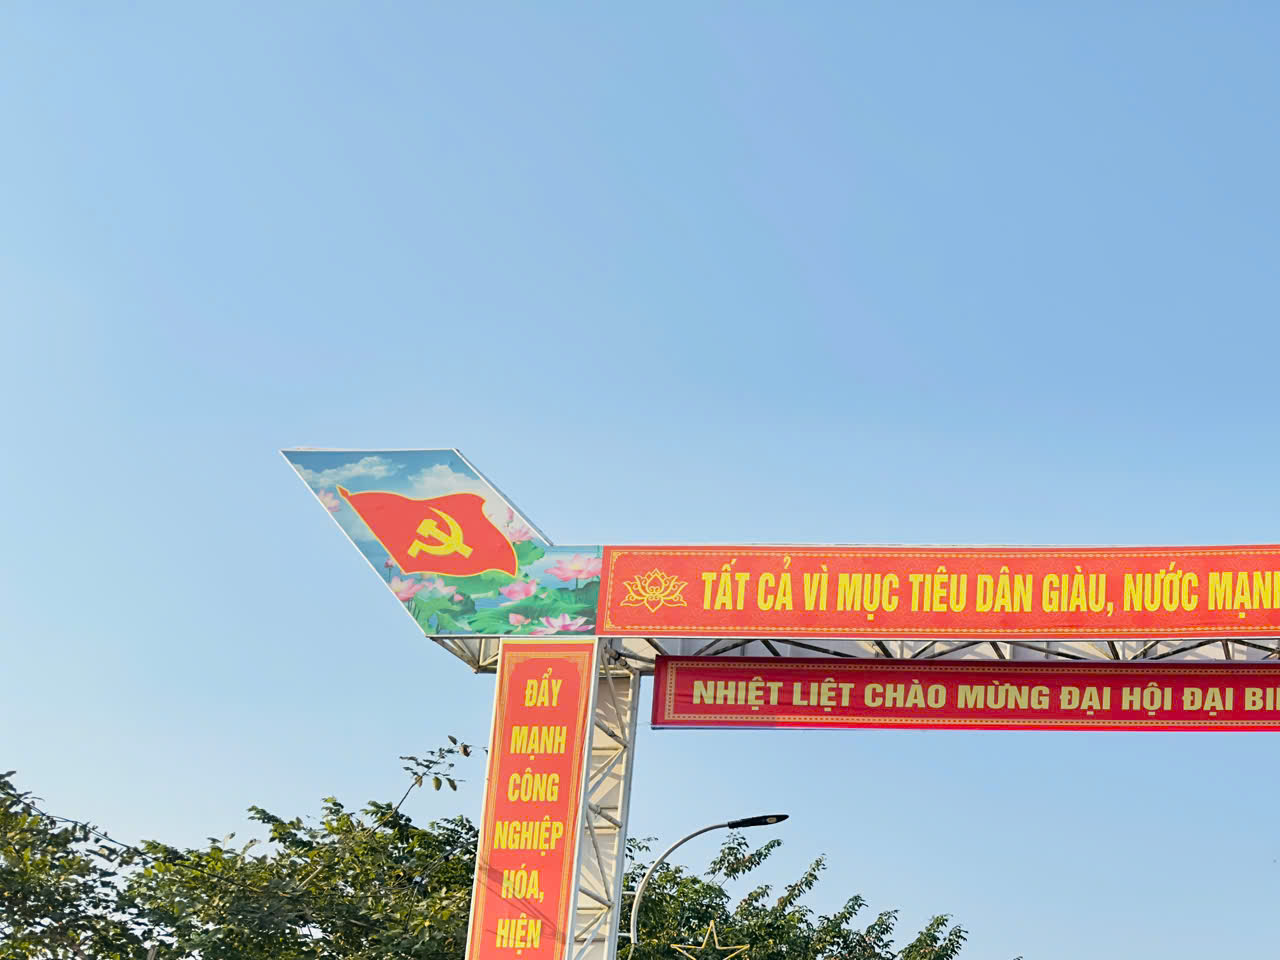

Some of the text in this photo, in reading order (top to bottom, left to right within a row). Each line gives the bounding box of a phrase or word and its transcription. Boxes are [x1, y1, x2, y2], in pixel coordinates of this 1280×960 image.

[702, 558, 750, 611] TẤT
[757, 553, 793, 611] CẢ
[803, 564, 829, 611] VÌ
[837, 572, 899, 620] MỤC
[908, 565, 968, 612] TIÊU
[975, 565, 1033, 613] DÂN
[1042, 565, 1114, 617] GIÀU,
[1123, 561, 1199, 612] NƯỚC
[524, 667, 562, 707] ĐẨY
[692, 675, 783, 711] NHIỆT
[792, 676, 855, 712] LIỆT
[864, 678, 947, 709] CHÀO
[957, 679, 1050, 710] MỪNG
[1060, 686, 1111, 716] ĐẠI
[1121, 681, 1172, 716] HỘI
[1182, 686, 1233, 716] ĐẠI
[510, 726, 567, 760] MẠNH
[507, 768, 560, 802] CÔNG
[493, 815, 563, 857] NGHIỆP
[501, 864, 544, 902] HÓA,
[495, 913, 542, 955] HIỆN
